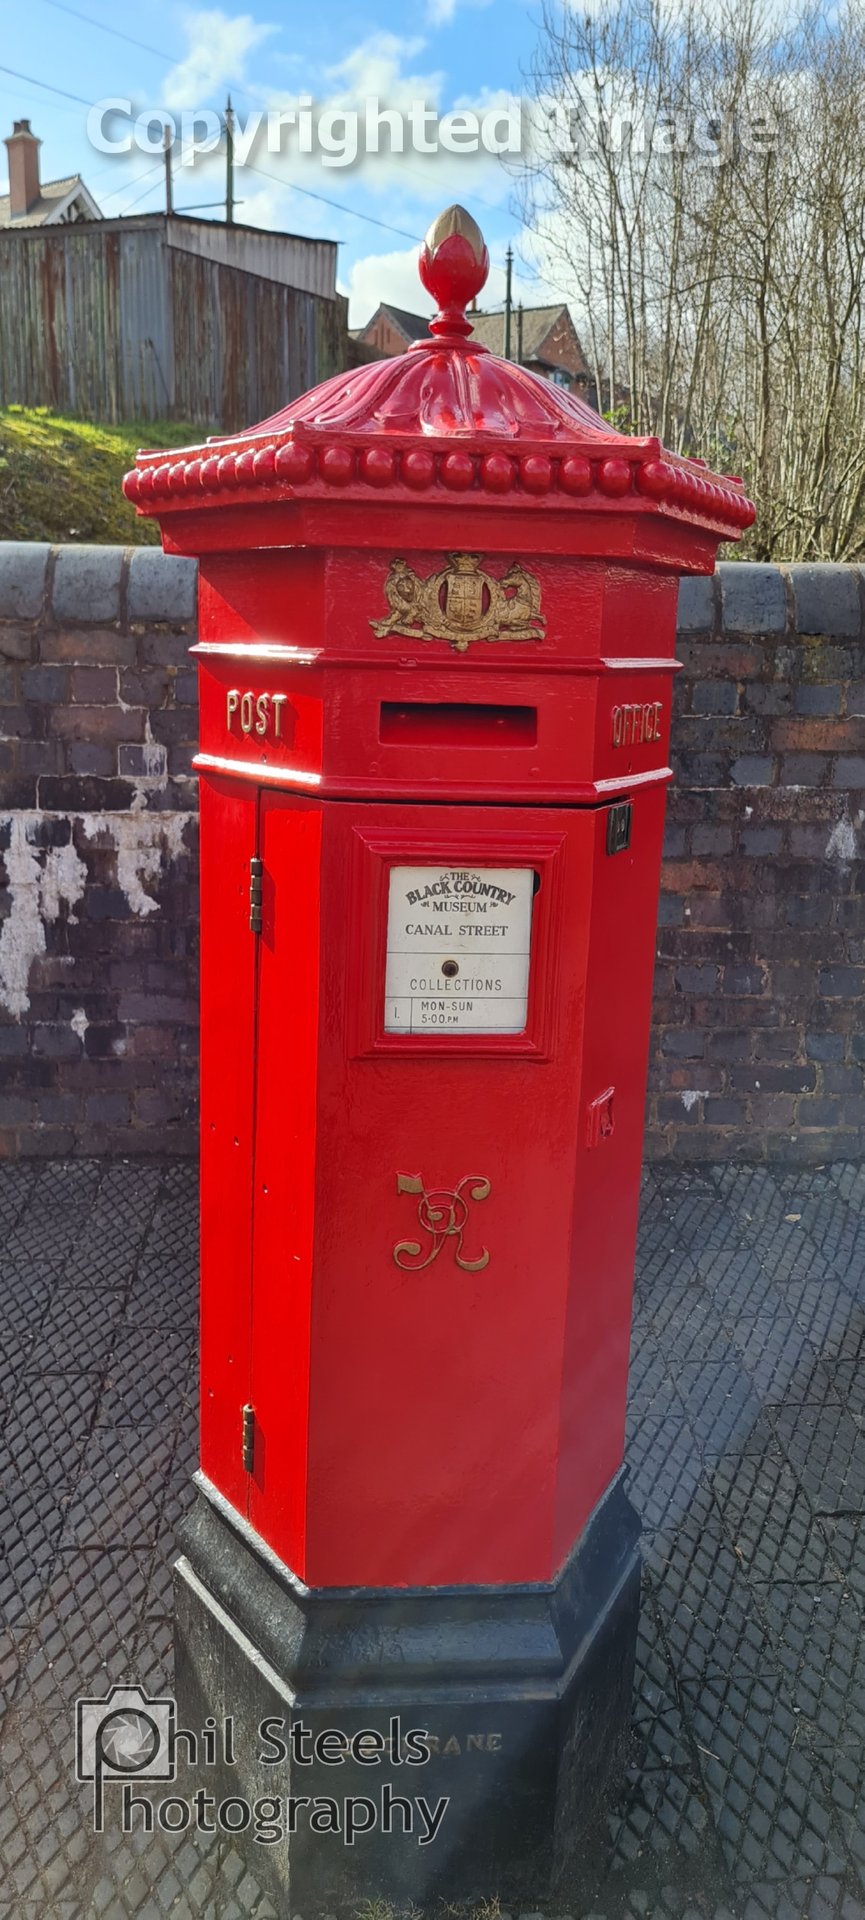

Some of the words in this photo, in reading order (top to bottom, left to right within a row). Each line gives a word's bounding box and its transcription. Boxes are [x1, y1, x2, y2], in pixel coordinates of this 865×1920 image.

[227, 689, 288, 737] POST
[612, 701, 662, 747] OFFICE
[450, 872, 470, 881] THE
[405, 880, 452, 906] BLACK
[453, 880, 516, 906] COUNTRY
[432, 901, 488, 913] MUSEUM
[405, 924, 452, 936] CANAL
[458, 925, 508, 937] STREET
[410, 978, 502, 991] COLLECTIONS
[421, 1001, 473, 1012] MON-SUN
